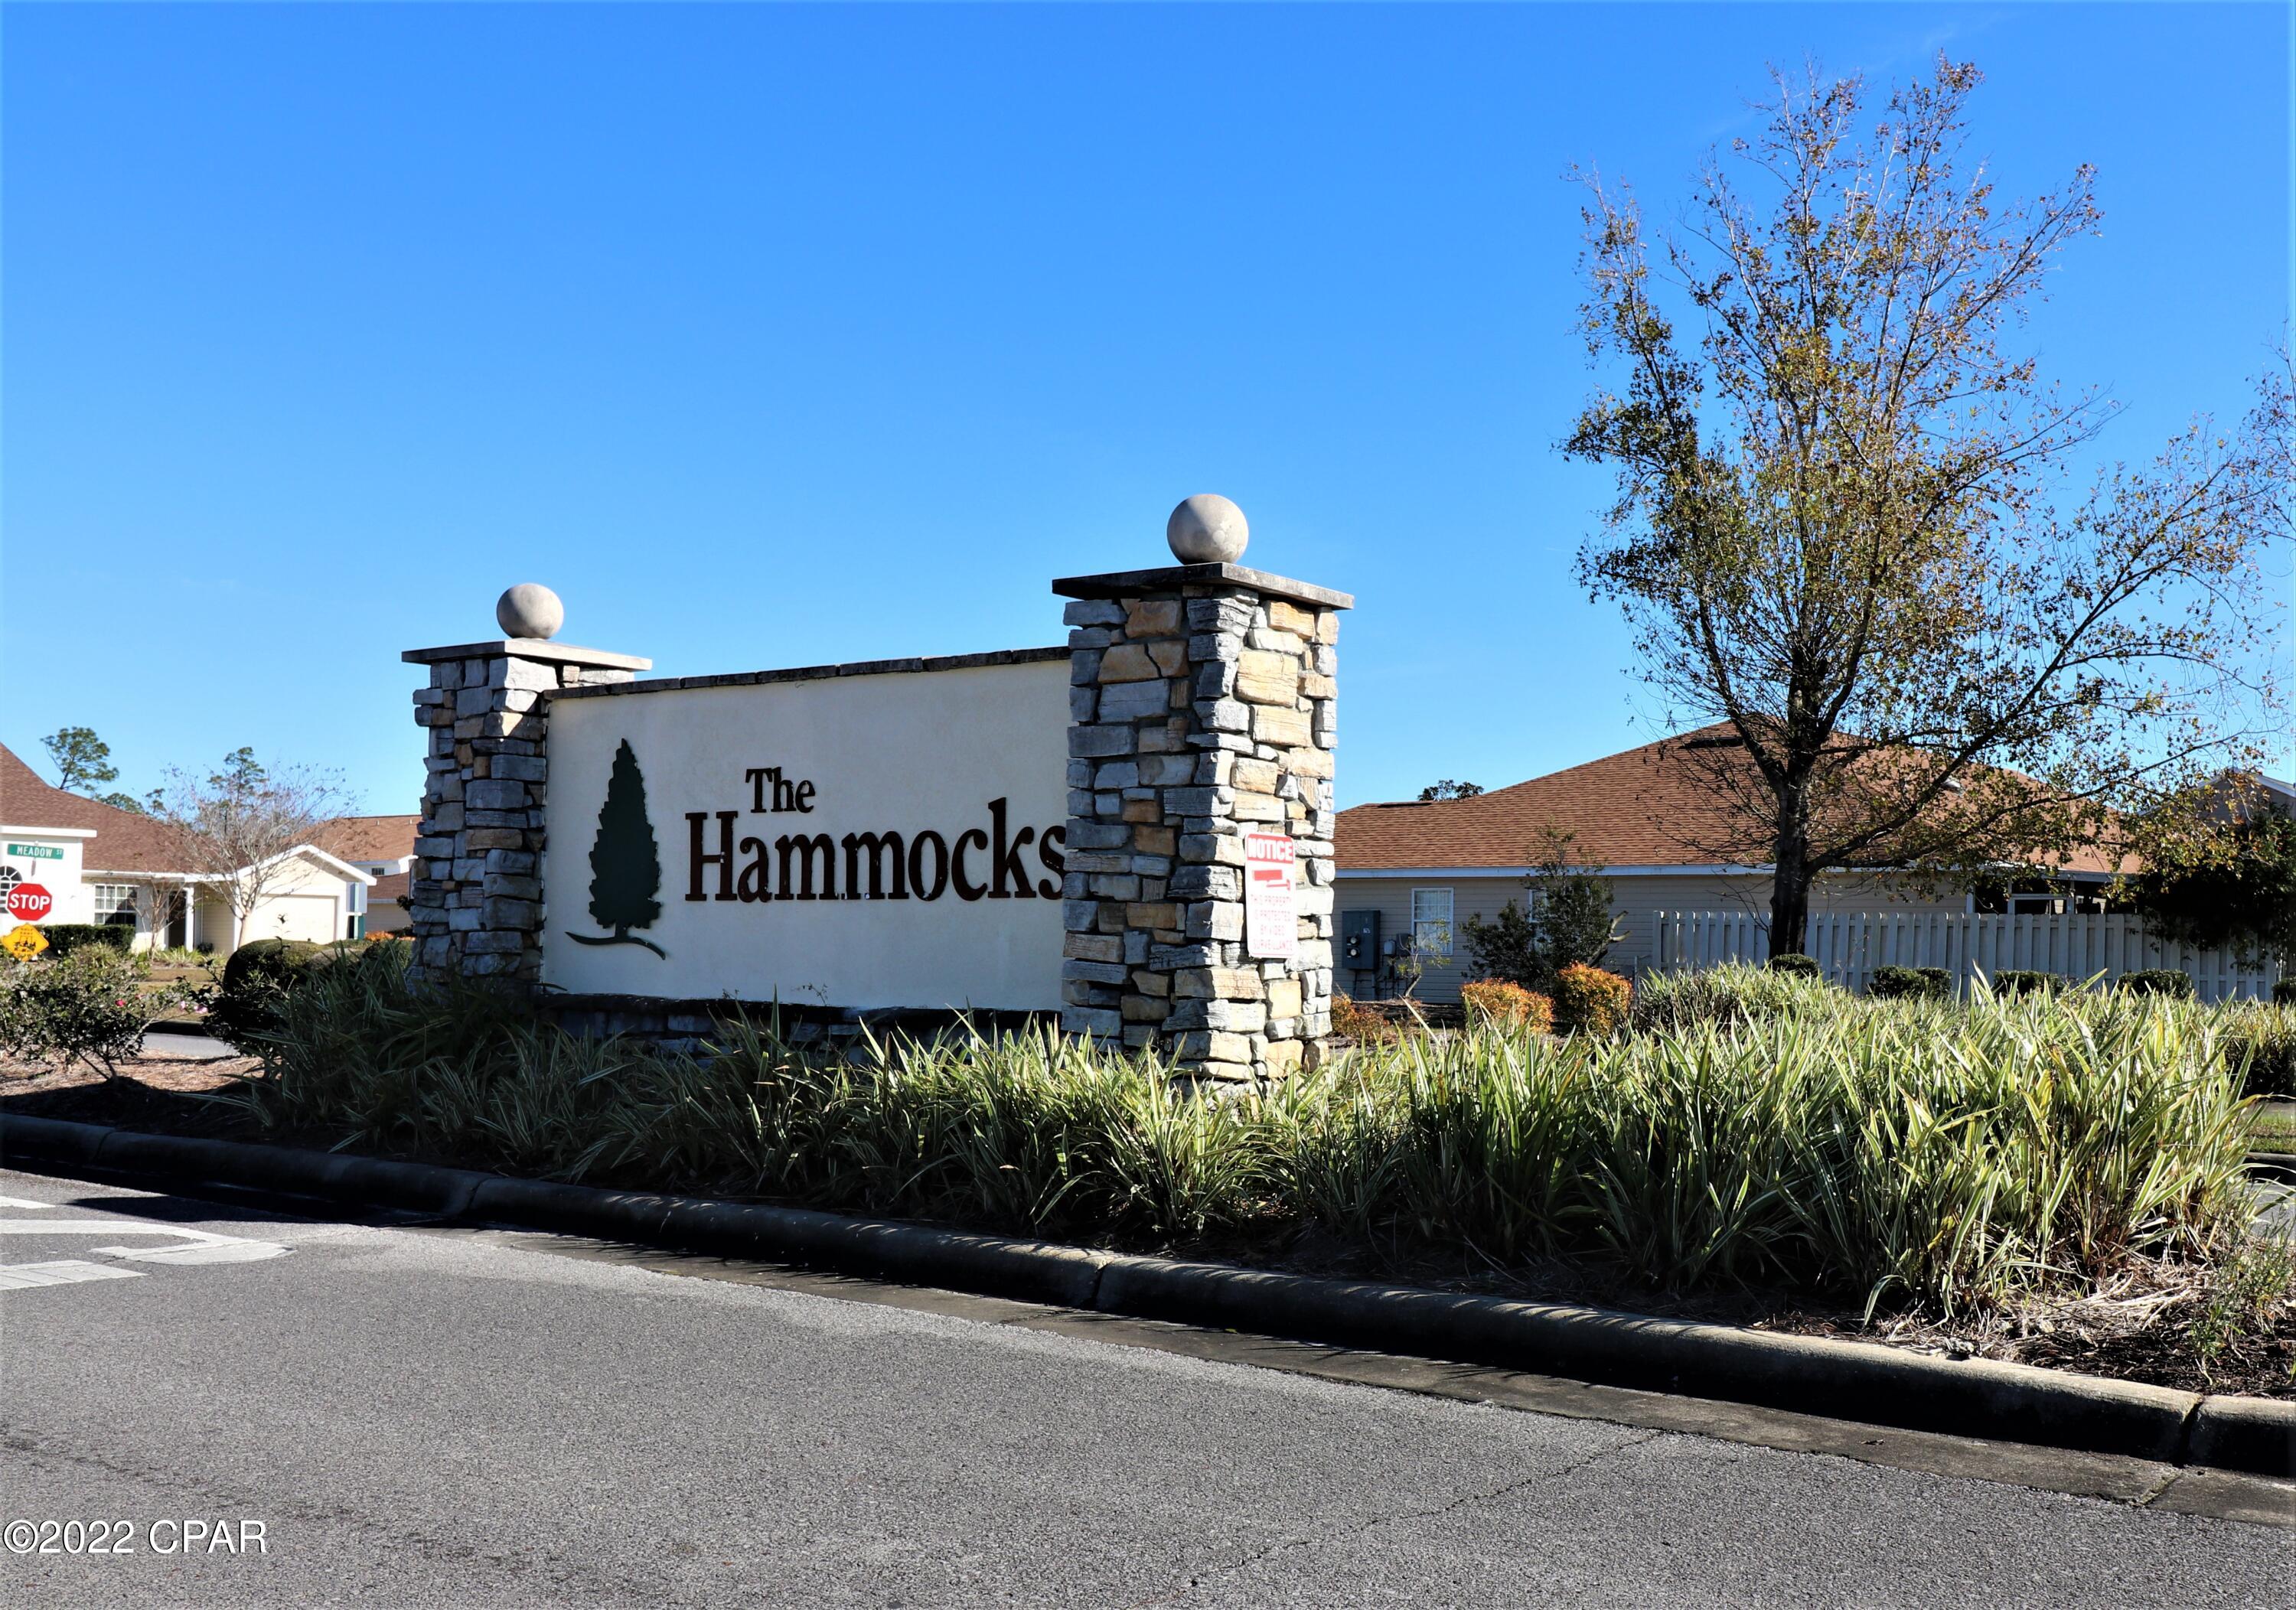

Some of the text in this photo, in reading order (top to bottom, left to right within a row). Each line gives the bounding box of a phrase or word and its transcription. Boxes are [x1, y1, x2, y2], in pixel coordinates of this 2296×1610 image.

[745, 766, 816, 813] The
[17, 846, 52, 858] MEADOW
[685, 797, 1066, 903] Hammocks
[1247, 837, 1293, 861] NOTICE
[9, 893, 51, 911] STOP
